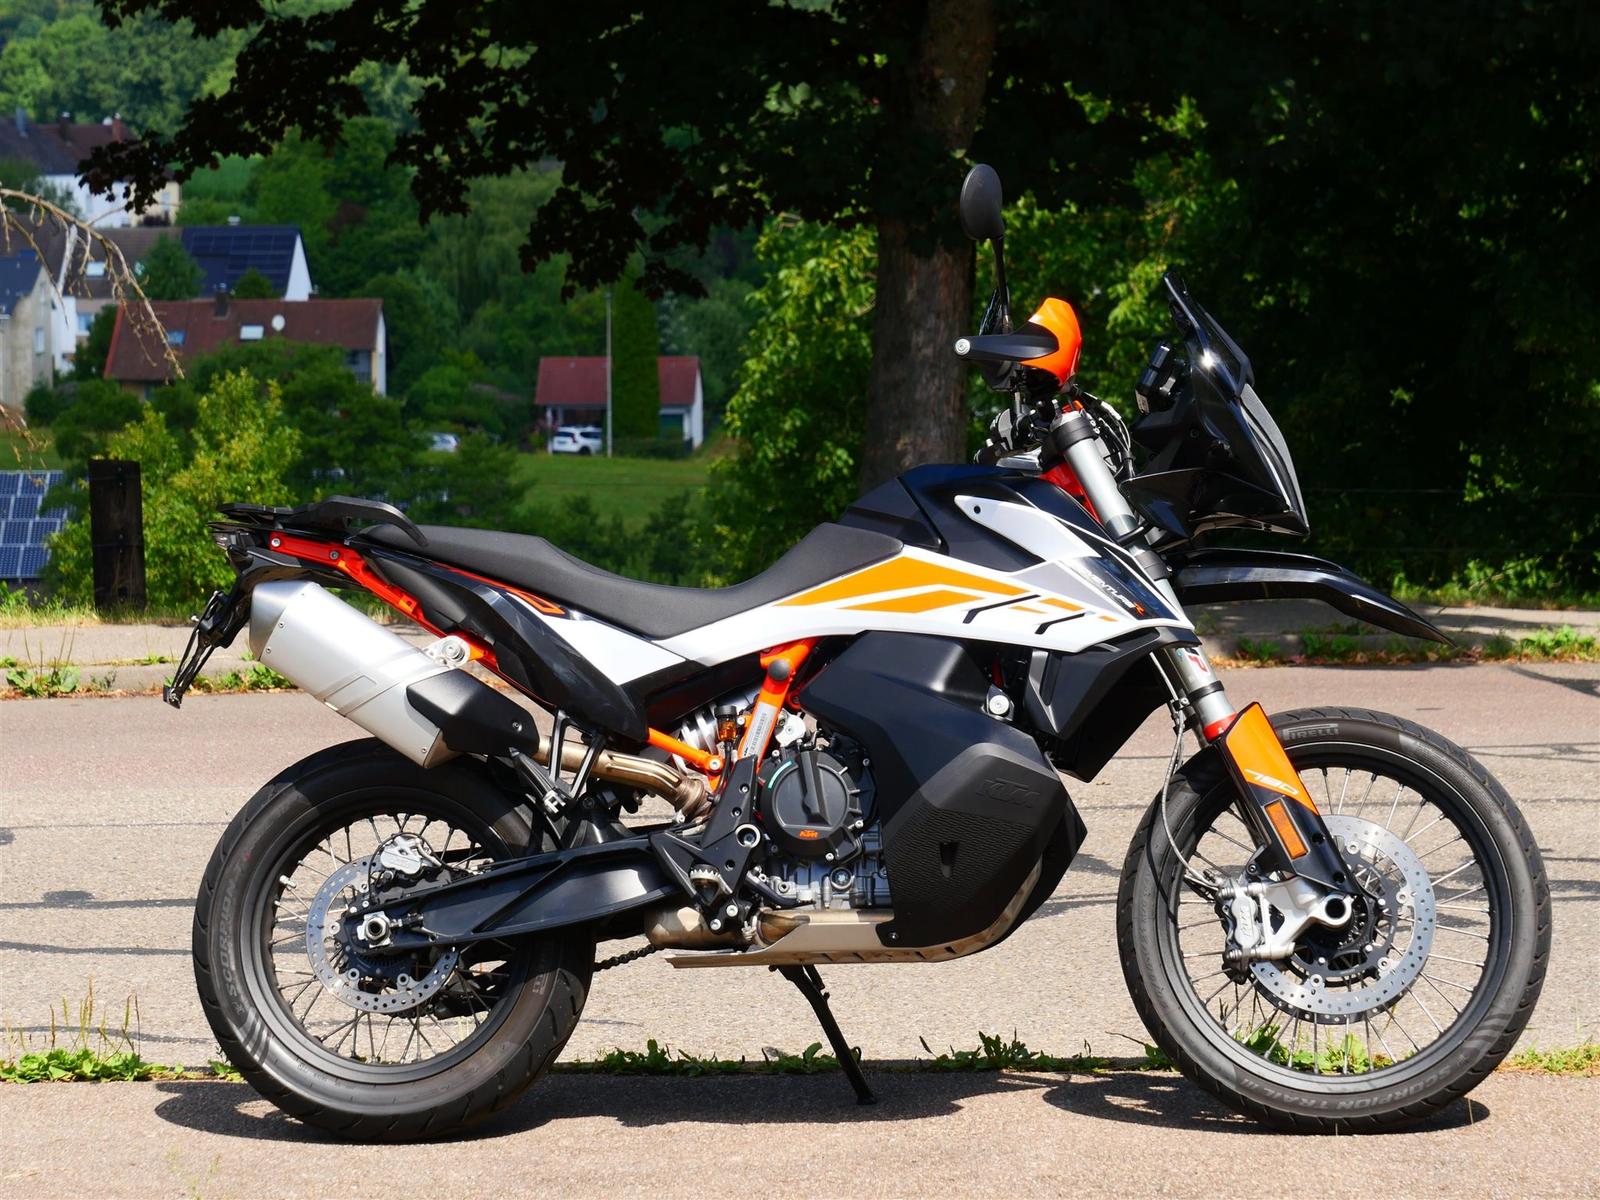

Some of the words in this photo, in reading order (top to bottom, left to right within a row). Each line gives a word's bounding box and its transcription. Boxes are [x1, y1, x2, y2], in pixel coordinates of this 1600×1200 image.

[1282, 723, 1339, 740] PIRELLI
[1244, 768, 1298, 795] 790
[799, 829, 818, 839] KTM
[219, 877, 238, 998] SCORPION
[1262, 1085, 1329, 1110] TRAIL
[1336, 1064, 1452, 1110] SCORPION
